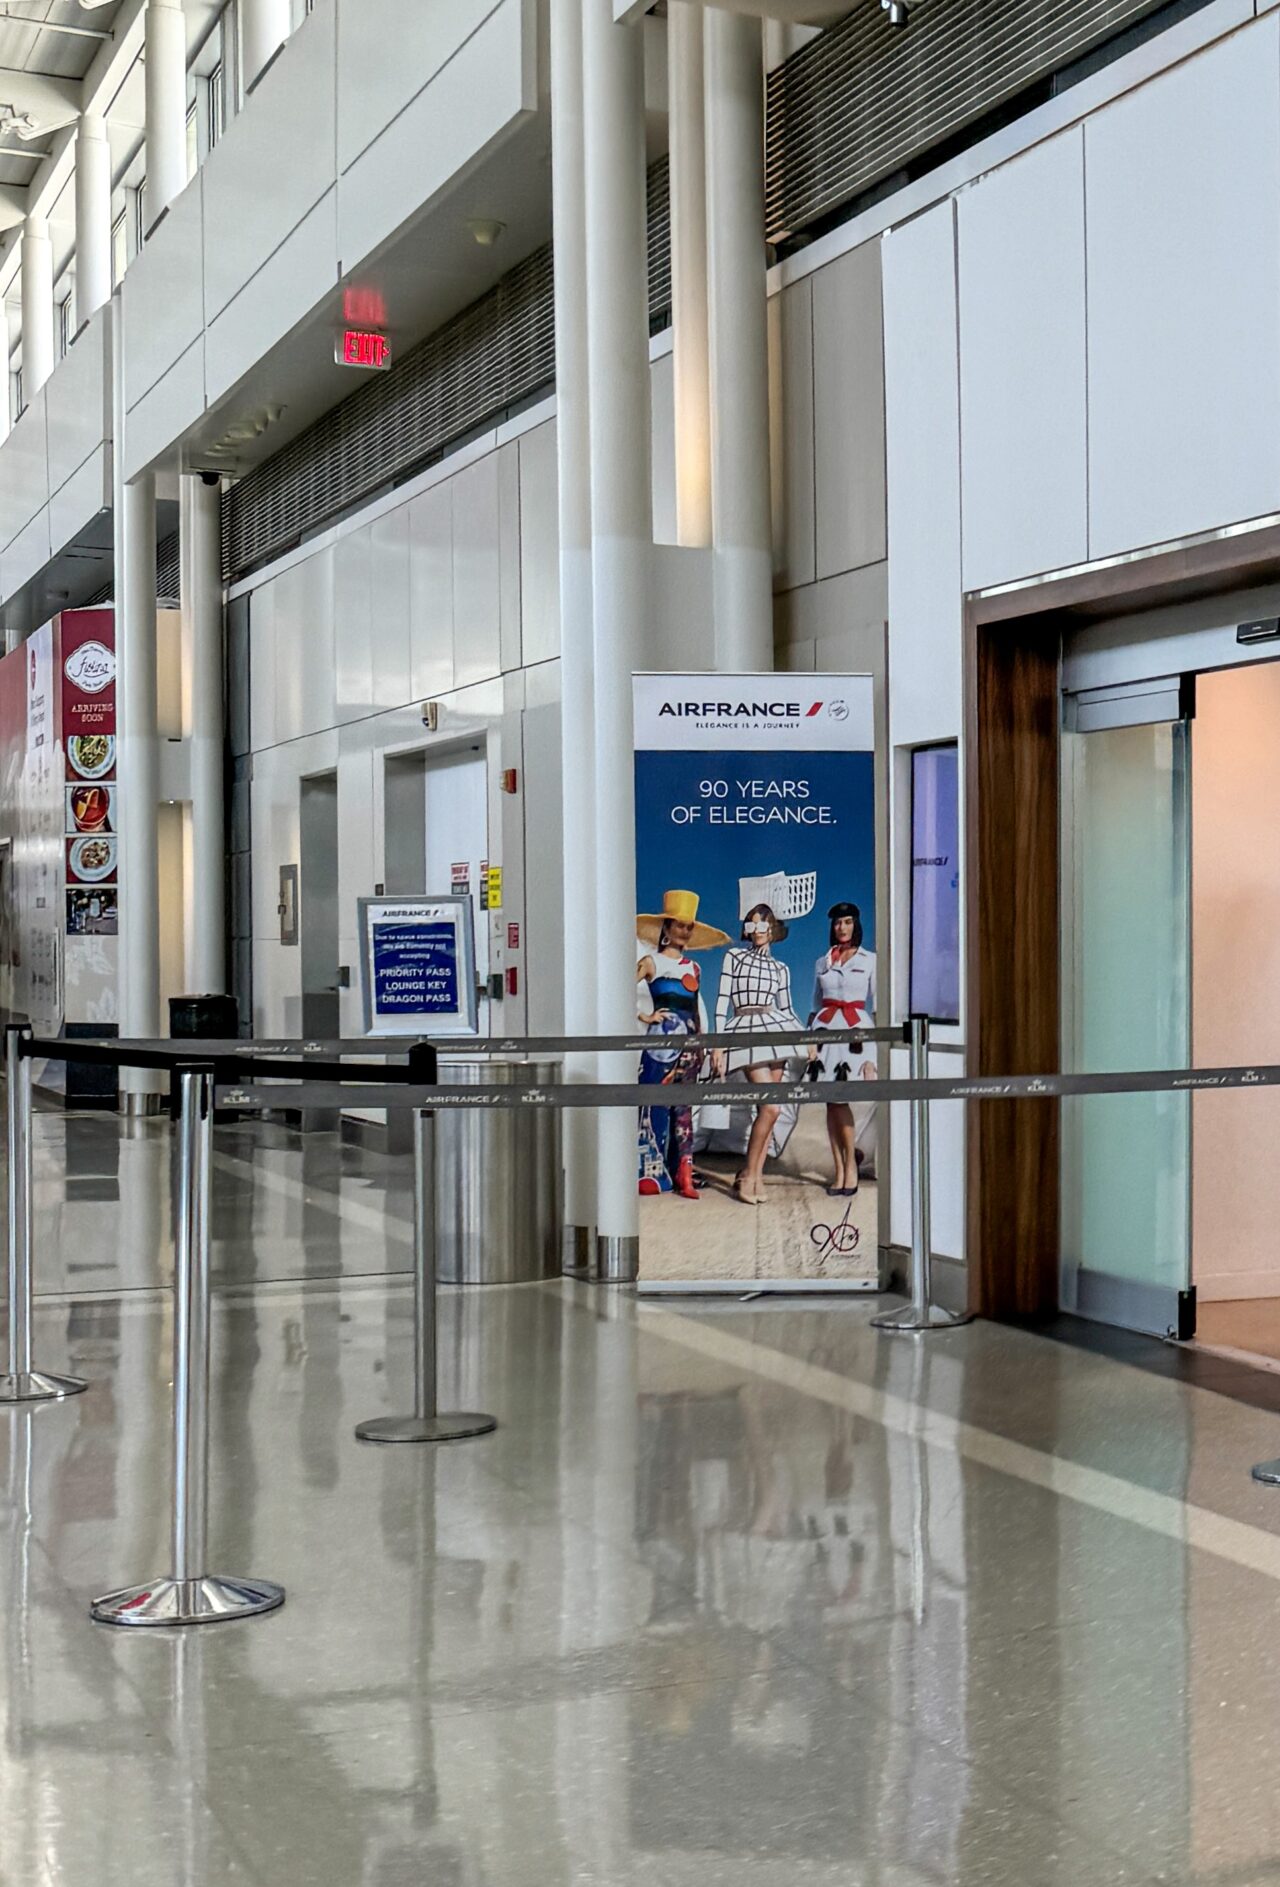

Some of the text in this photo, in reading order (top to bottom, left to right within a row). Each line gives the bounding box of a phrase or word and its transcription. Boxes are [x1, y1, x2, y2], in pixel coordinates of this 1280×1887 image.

[344, 331, 384, 367] EXIT
[658, 702, 801, 717] AIRFRANCE
[81, 713, 104, 723] SOON
[699, 780, 810, 798] 90 YEARS
[671, 806, 837, 824] OF ELEGANCE.
[380, 968, 452, 977] PRIORITY PASS
[385, 981, 447, 990] LOUNGE KEY
[382, 994, 451, 1003] DRAGON PASS
[425, 1095, 490, 1104] AIRFRANCE
